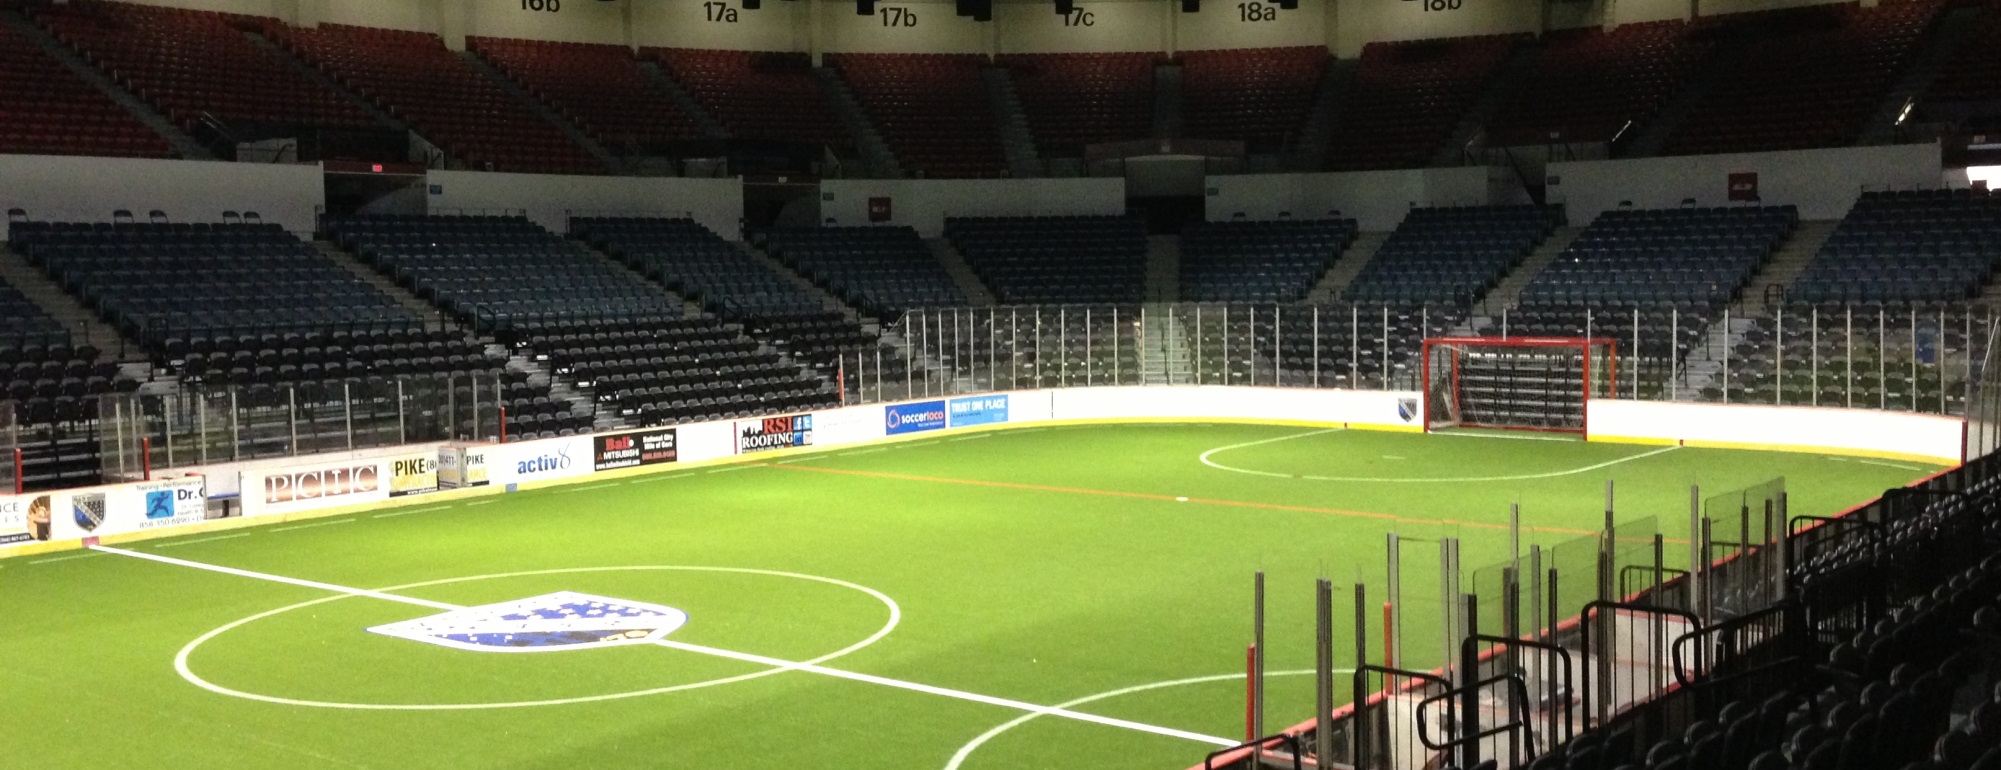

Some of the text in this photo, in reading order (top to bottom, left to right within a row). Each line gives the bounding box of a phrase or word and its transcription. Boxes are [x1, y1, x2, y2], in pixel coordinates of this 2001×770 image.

[703, 1, 738, 23] 17a
[880, 7, 917, 27] 17b
[1064, 7, 1095, 27] 17c
[1237, 2, 1276, 22] 18a
[951, 399, 1006, 413] TRUST ONE PLACE
[763, 416, 793, 434] RSI
[901, 411, 944, 424] soccerloco
[742, 432, 793, 449] ROOFING
[466, 454, 485, 465] PIKE
[603, 448, 640, 460] MITSUBISHI
[395, 458, 425, 477] PIKE
[269, 466, 376, 501] PCIC
[177, 489, 198, 500] Dr.
